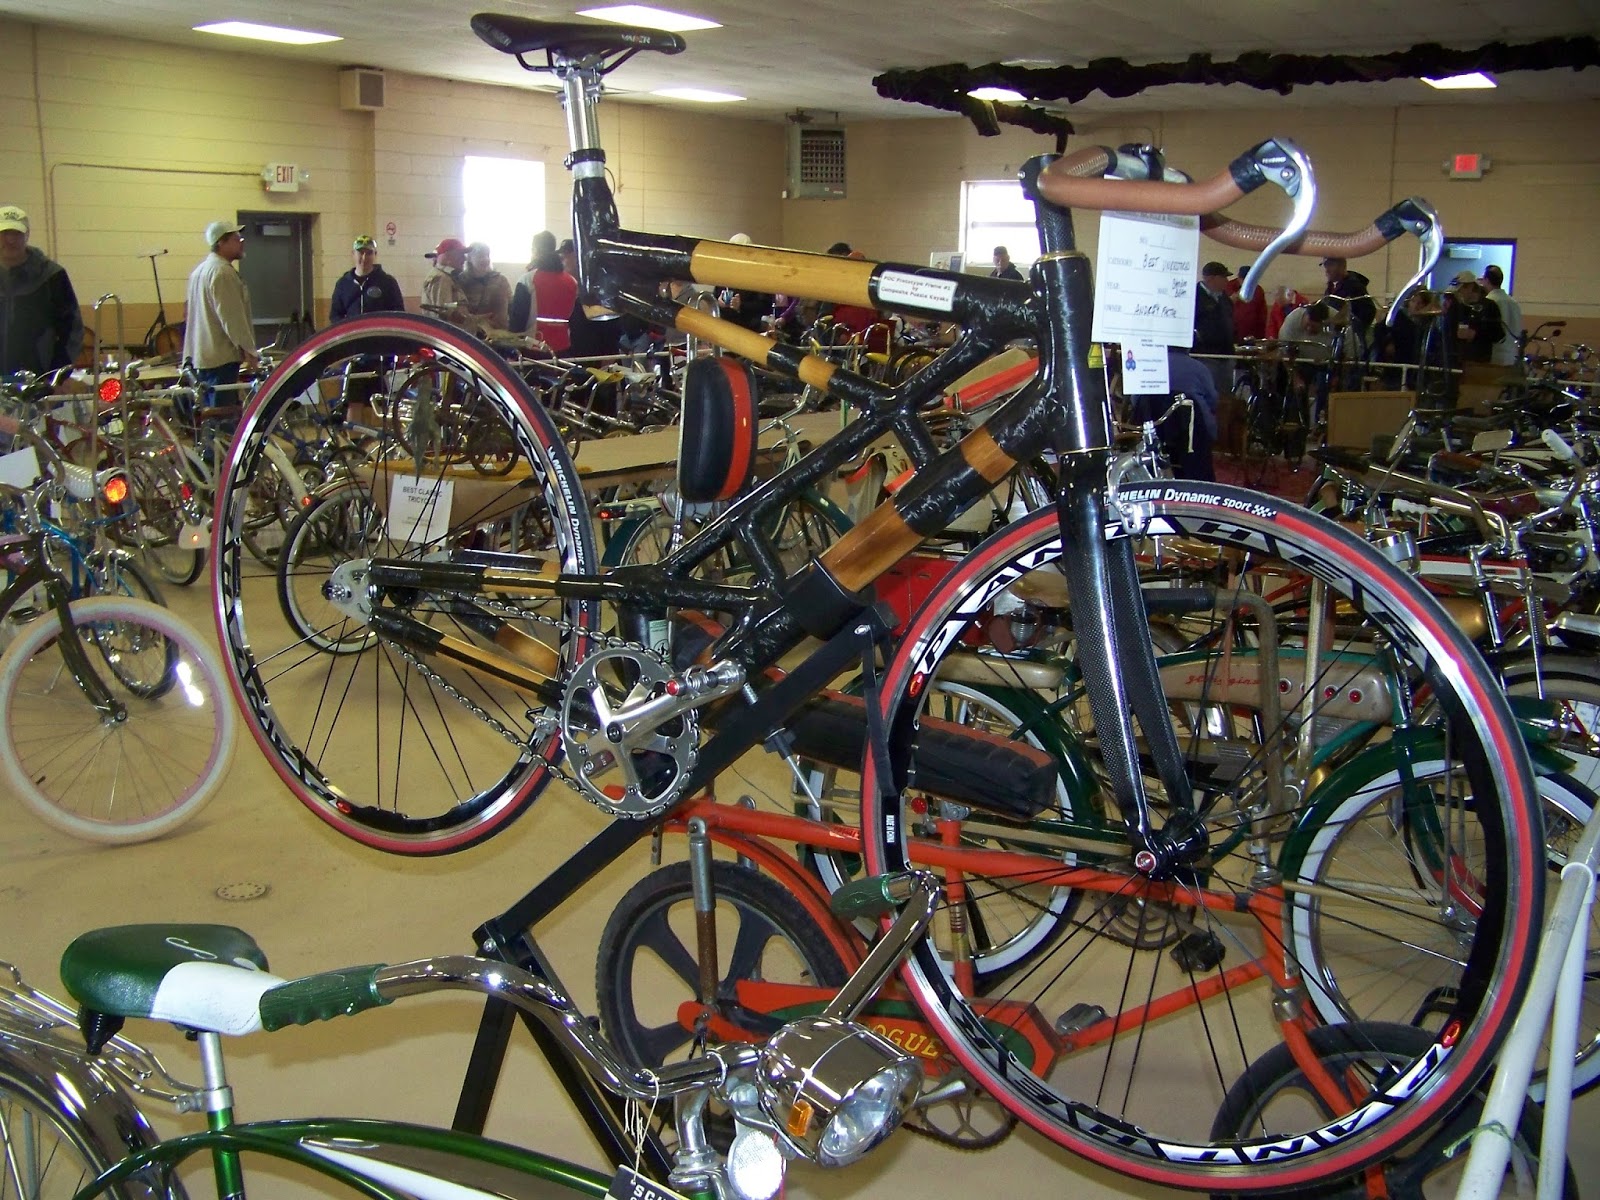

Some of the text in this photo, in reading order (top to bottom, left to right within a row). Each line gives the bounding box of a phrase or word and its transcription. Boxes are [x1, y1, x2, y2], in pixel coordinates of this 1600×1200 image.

[276, 165, 294, 183] EXIT
[896, 277, 924, 287] Prototype
[402, 486, 443, 498] BEST CLASC
[1164, 488, 1221, 505] Dynamic
[1221, 497, 1252, 512] sport
[552, 458, 585, 566] MICHELIN Dynamic
[872, 1023, 939, 1058] OGUE
